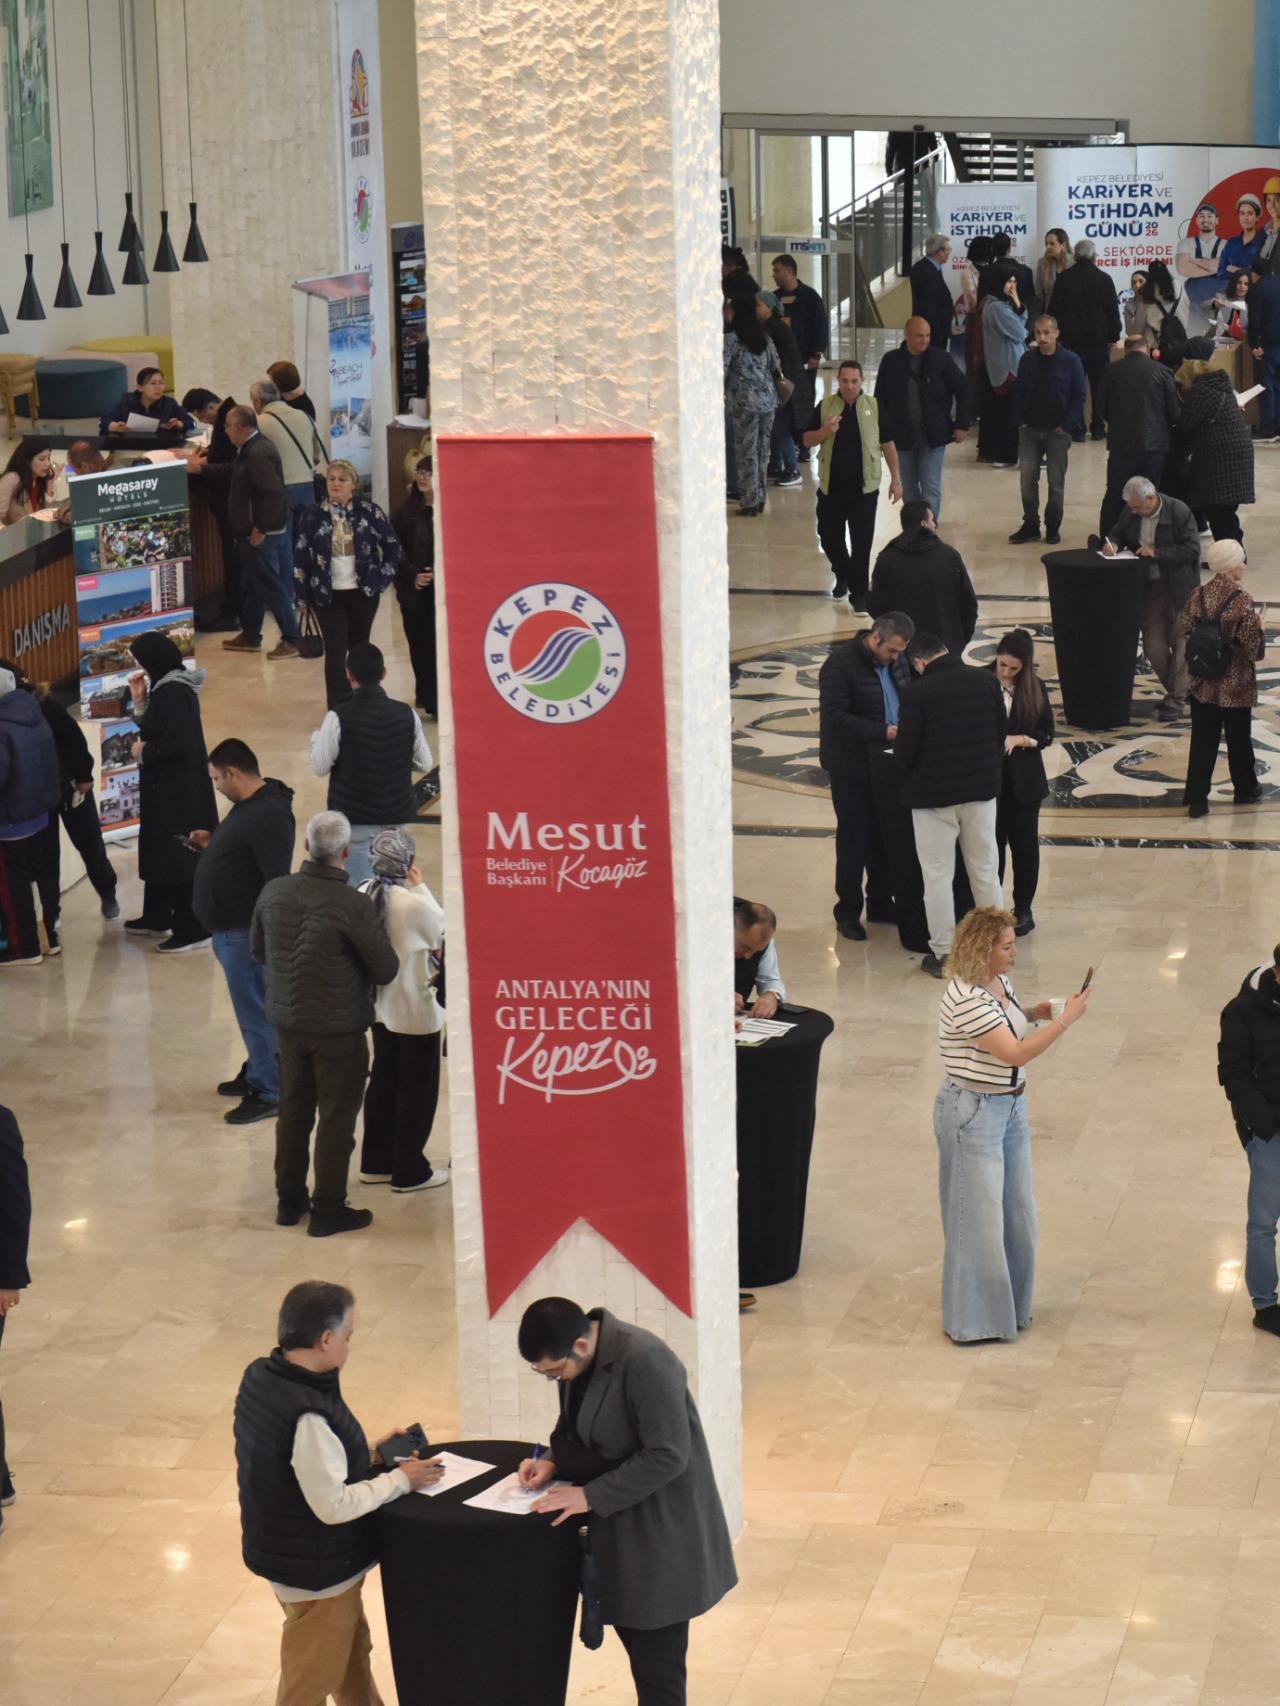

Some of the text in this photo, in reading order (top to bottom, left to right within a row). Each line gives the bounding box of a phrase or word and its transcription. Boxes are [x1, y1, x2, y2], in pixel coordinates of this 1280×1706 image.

[1155, 187, 1173, 198] VE
[1085, 221, 1143, 237] GÜNÜ
[98, 477, 158, 496] Megasaray
[110, 493, 147, 503] HOTELS
[493, 589, 613, 637] KEPEZ
[486, 812, 647, 850] Mesut
[486, 858, 547, 874] Belediye
[556, 854, 647, 892] Kocagöz
[487, 873, 547, 888] Başkanı
[495, 979, 650, 999] ANTALYA'NIN
[495, 1003, 652, 1030] GELECEĞİ
